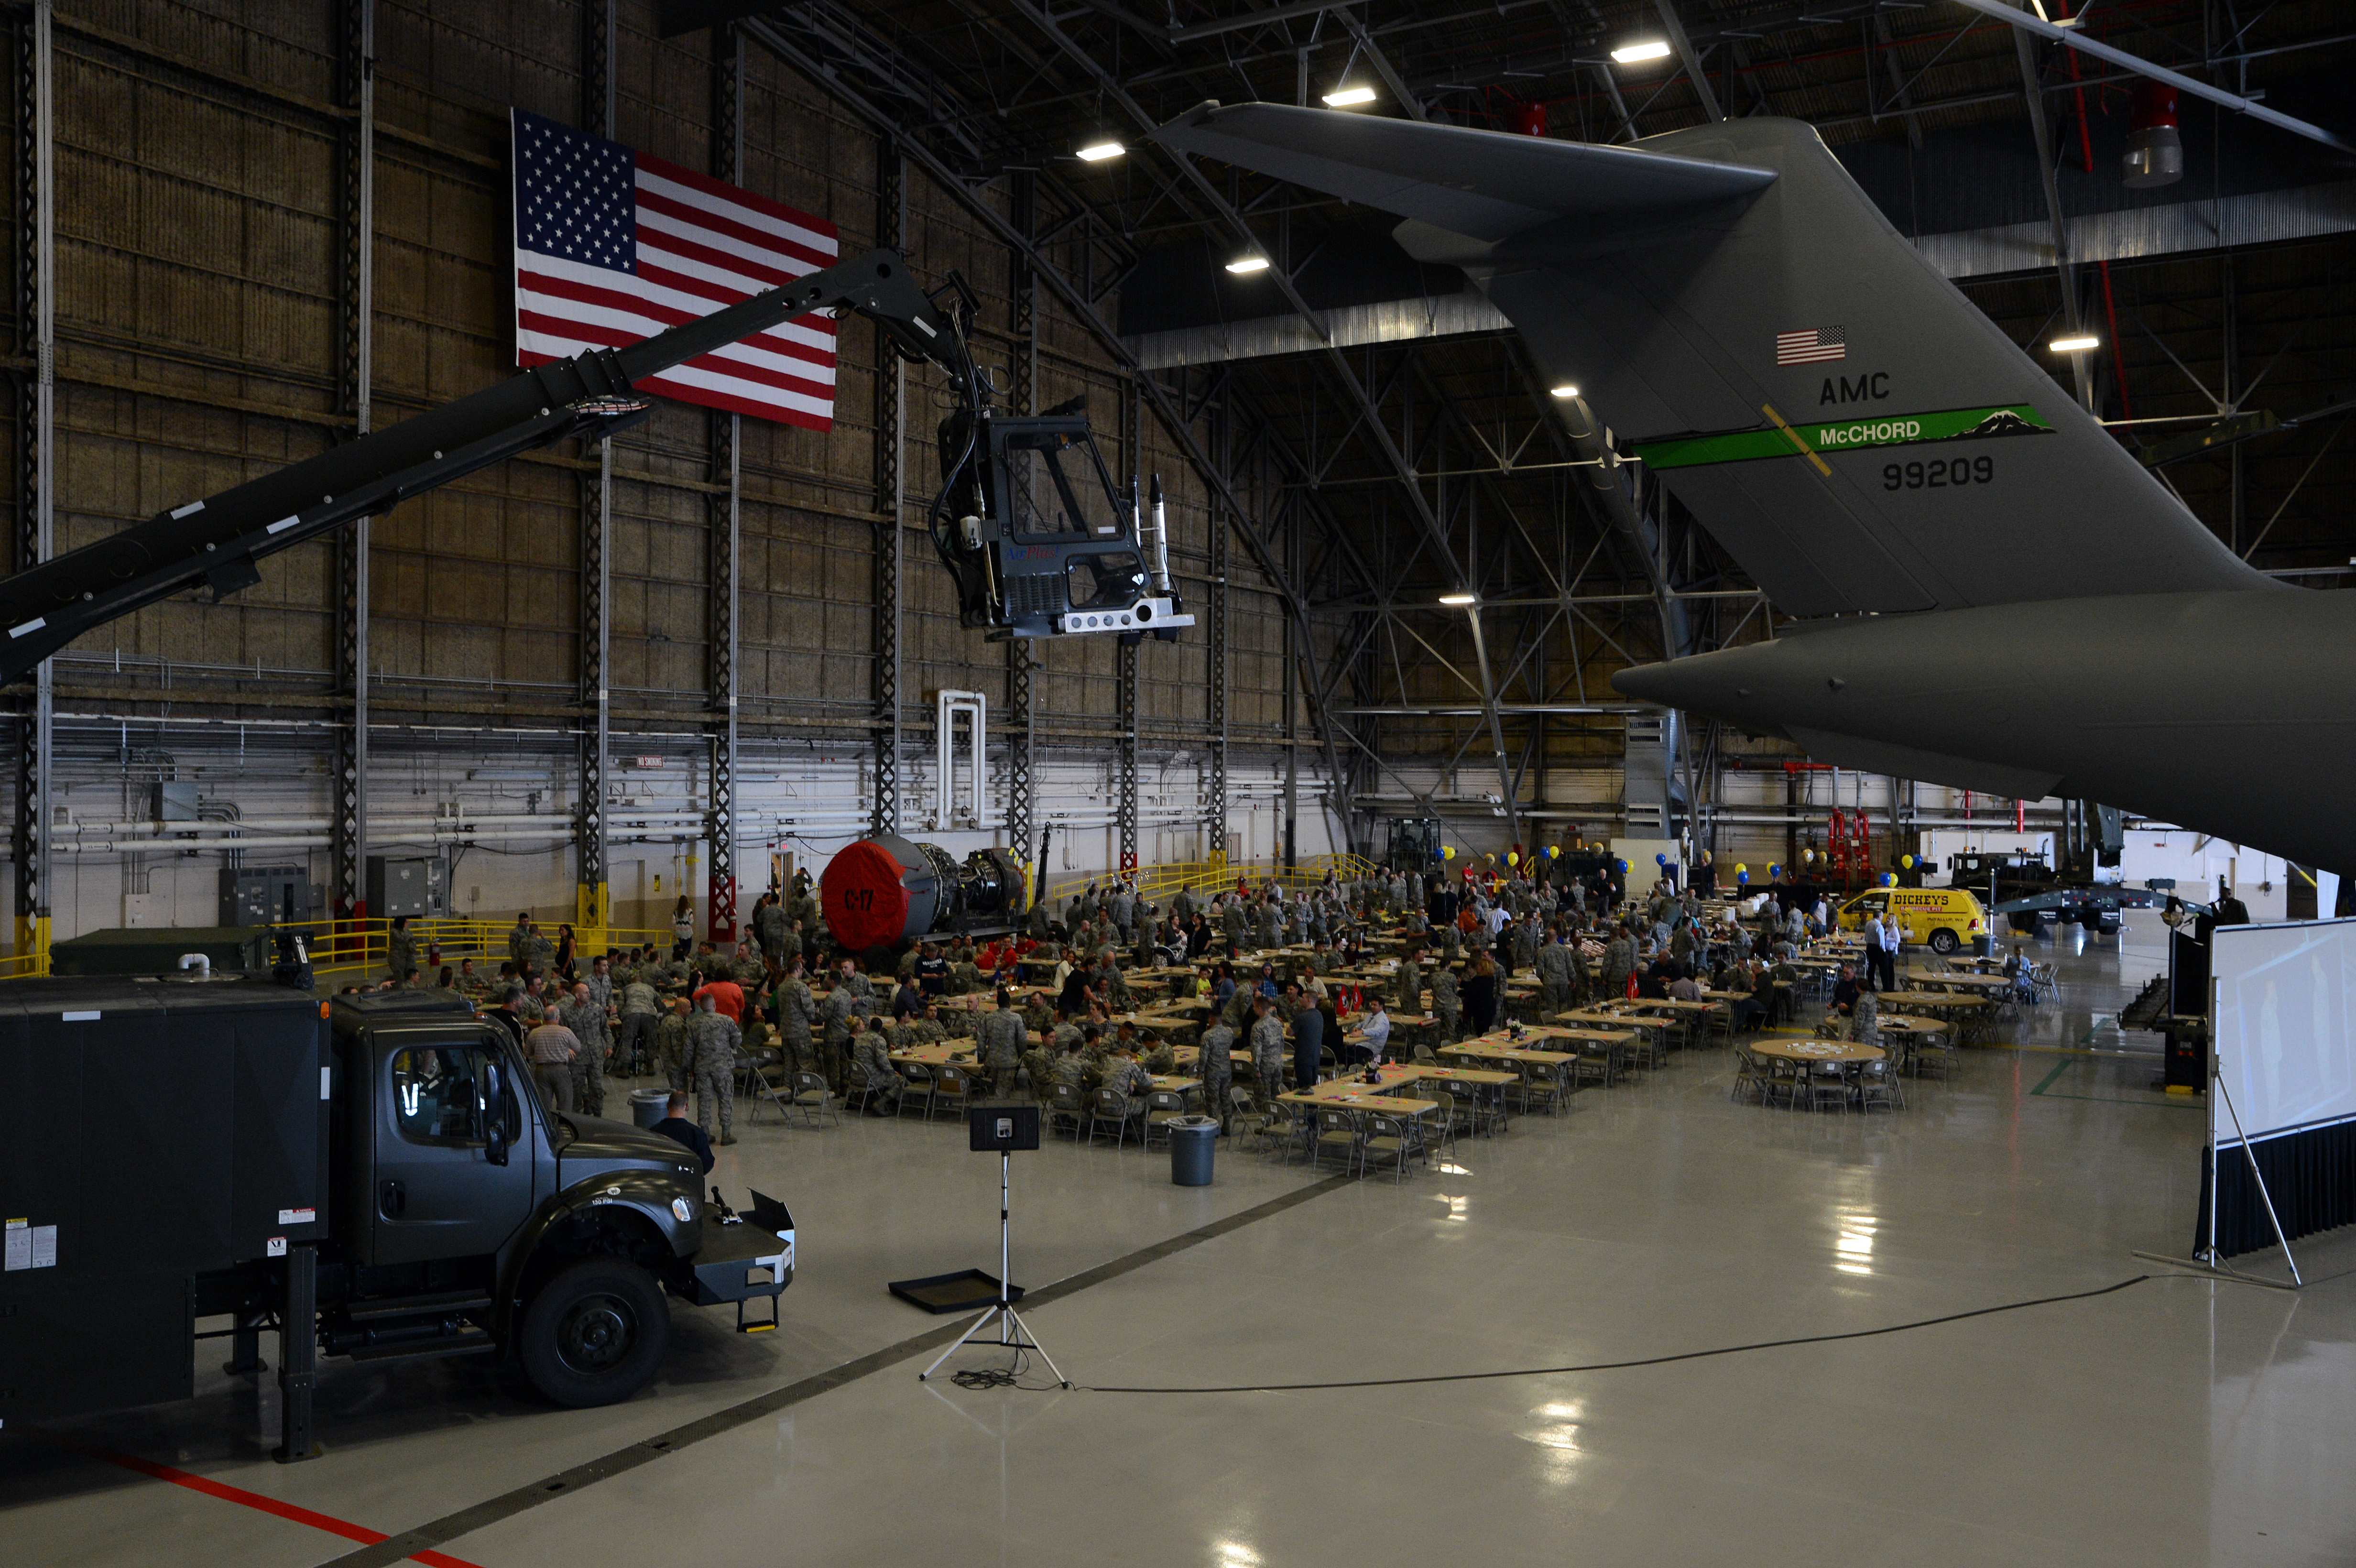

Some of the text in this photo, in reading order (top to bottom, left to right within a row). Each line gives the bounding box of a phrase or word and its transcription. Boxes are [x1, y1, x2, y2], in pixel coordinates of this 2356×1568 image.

[1819, 372, 1890, 406] AMC
[1820, 421, 1921, 446] McCHORD
[1883, 456, 1994, 491] 99209
[638, 757, 662, 766] NO SMOKING
[845, 889, 874, 911] C-17
